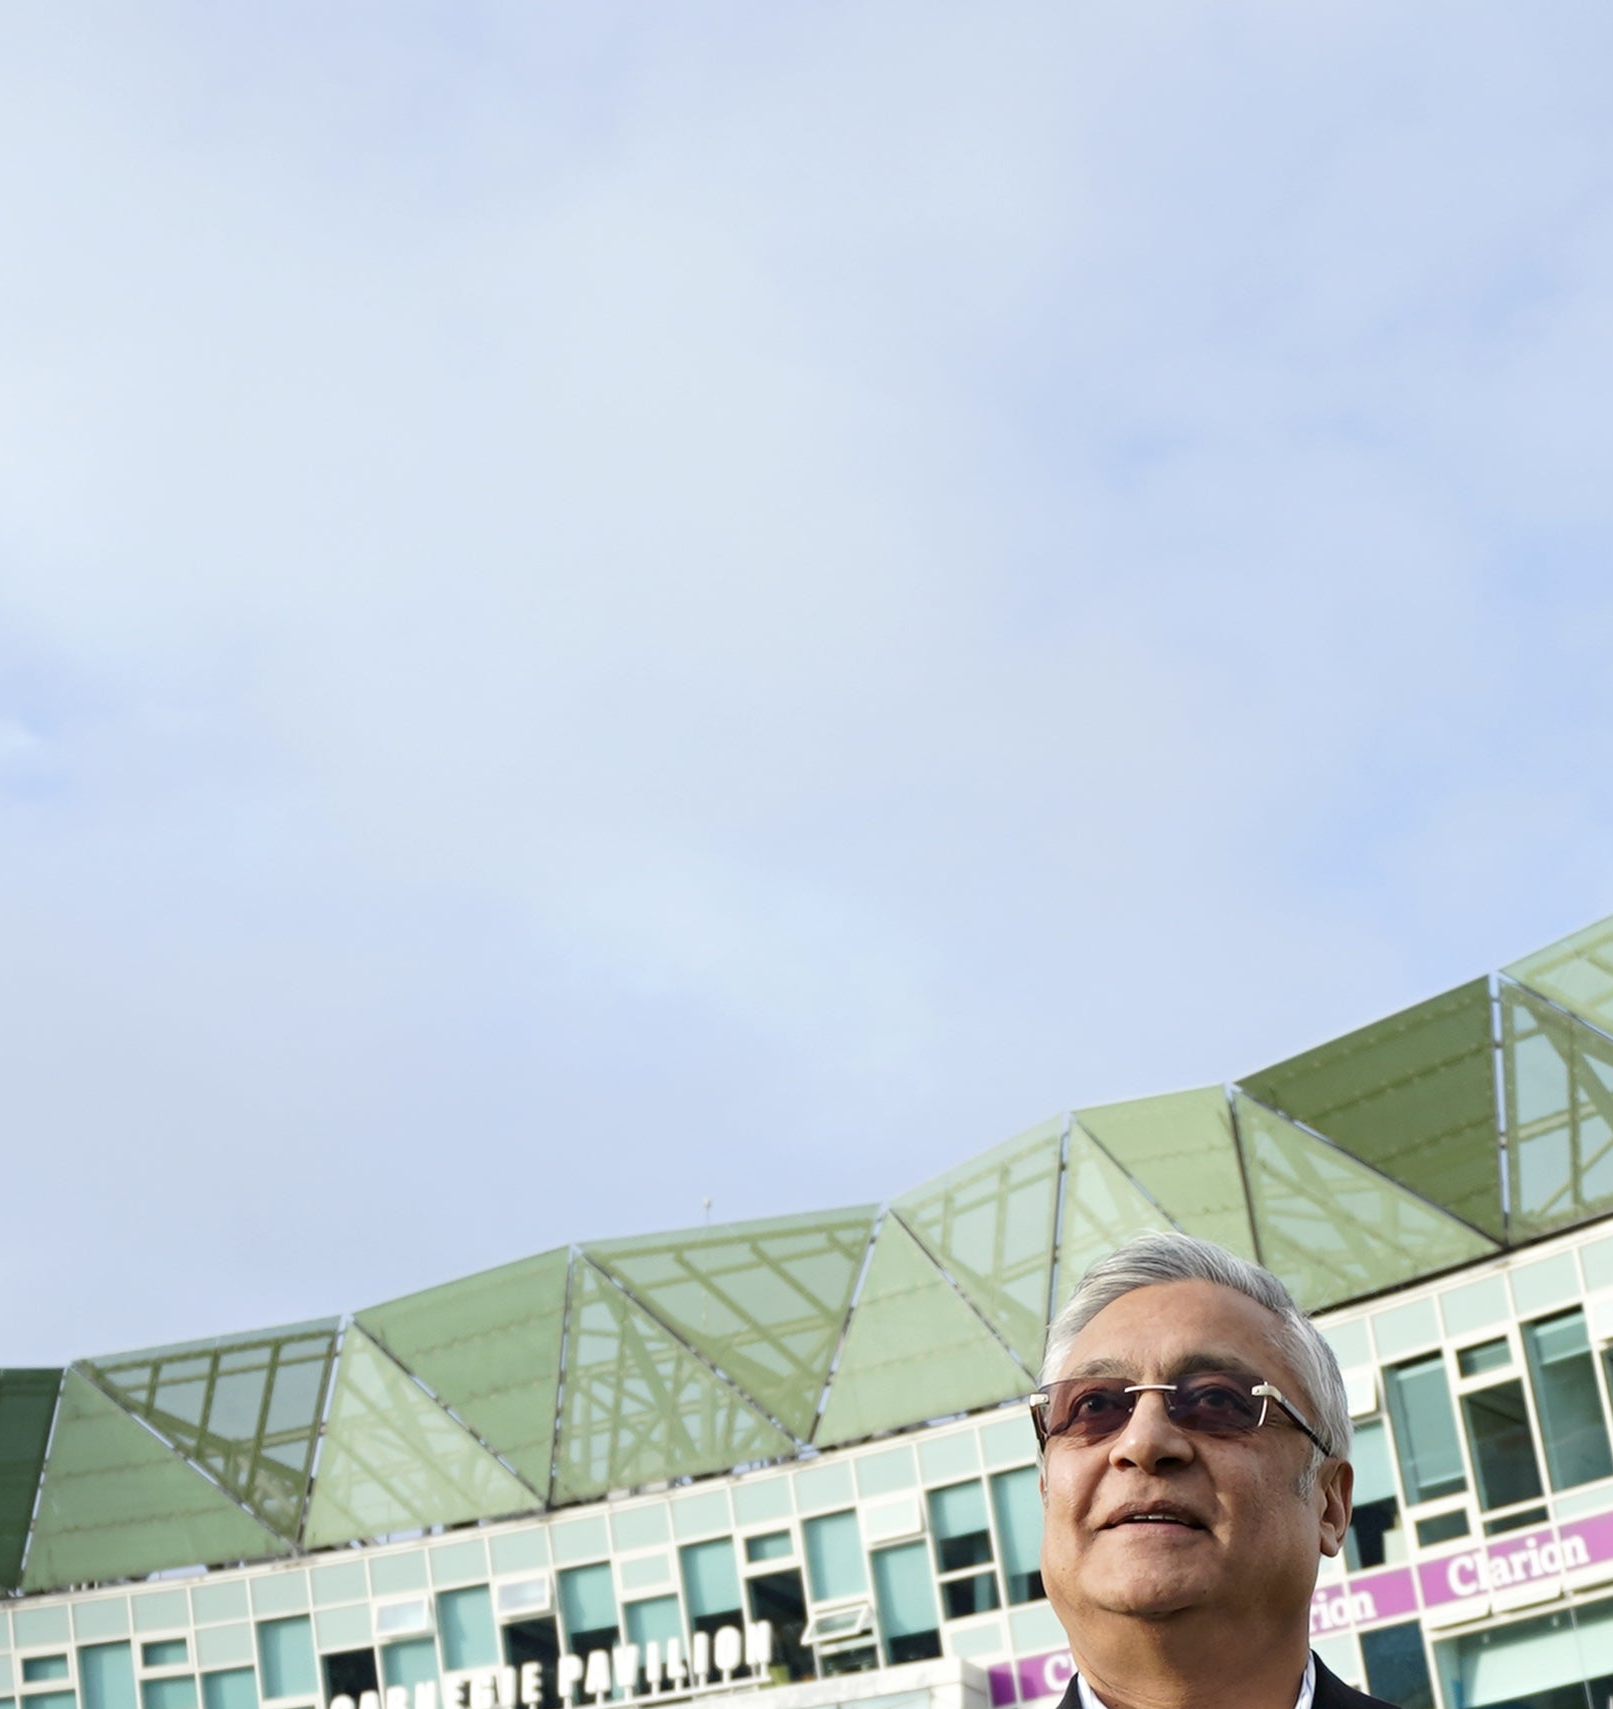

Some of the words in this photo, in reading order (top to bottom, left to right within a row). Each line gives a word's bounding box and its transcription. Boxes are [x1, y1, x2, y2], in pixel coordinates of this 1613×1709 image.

[1447, 1535, 1590, 1597] Clarion
[1309, 1590, 1378, 1632] rion
[557, 1619, 773, 1698] PAVILION
